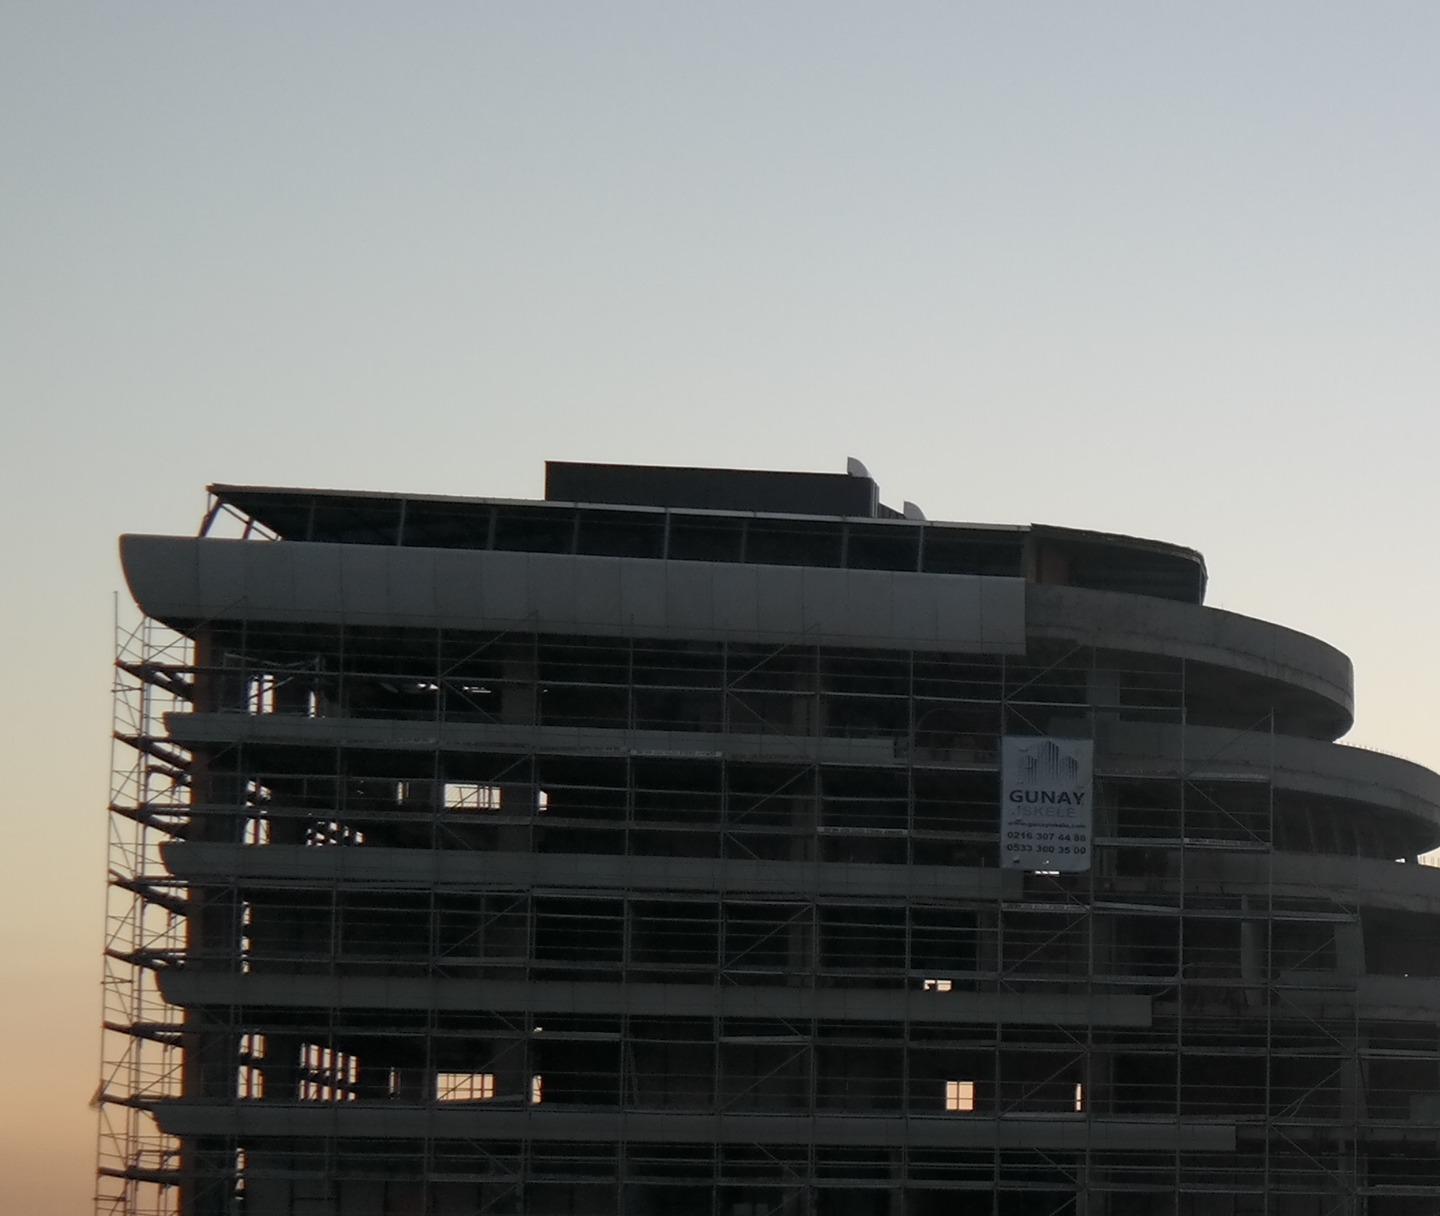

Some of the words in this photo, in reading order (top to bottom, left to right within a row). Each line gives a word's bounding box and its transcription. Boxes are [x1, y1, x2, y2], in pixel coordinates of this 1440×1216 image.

[1007, 831, 1033, 839] 0216
[1036, 832, 1054, 840] 307
[1007, 843, 1033, 852] 0533
[1058, 846, 1071, 854] 35
[1073, 846, 1086, 855] 00
